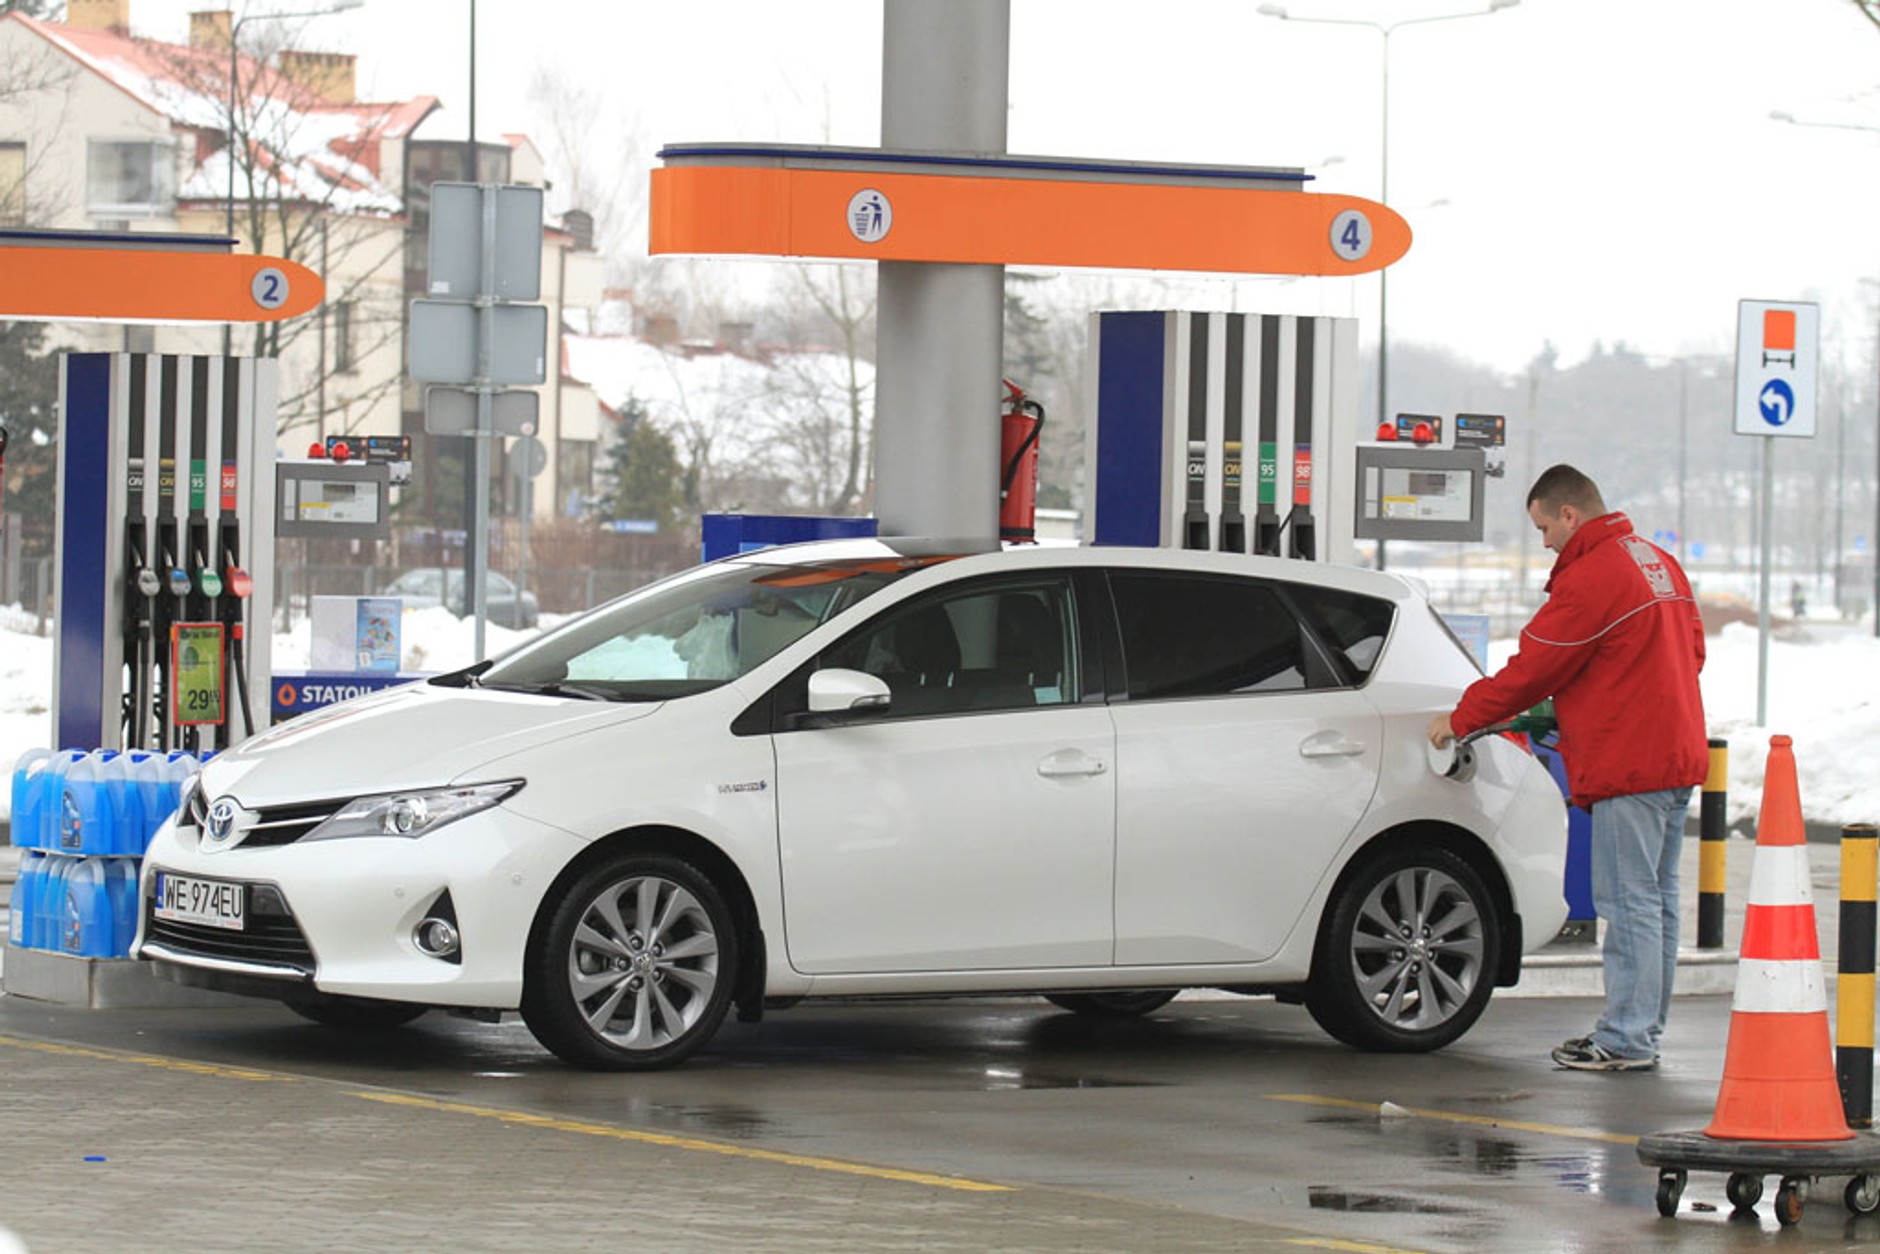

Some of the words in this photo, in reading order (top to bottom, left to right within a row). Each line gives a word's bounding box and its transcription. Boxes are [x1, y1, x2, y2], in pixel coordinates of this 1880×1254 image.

[1341, 218, 1361, 251] 4
[262, 275, 279, 302] 2
[191, 478, 204, 488] 95
[1261, 465, 1274, 476] 95
[165, 878, 187, 911] WE
[192, 882, 242, 918] 974EU
